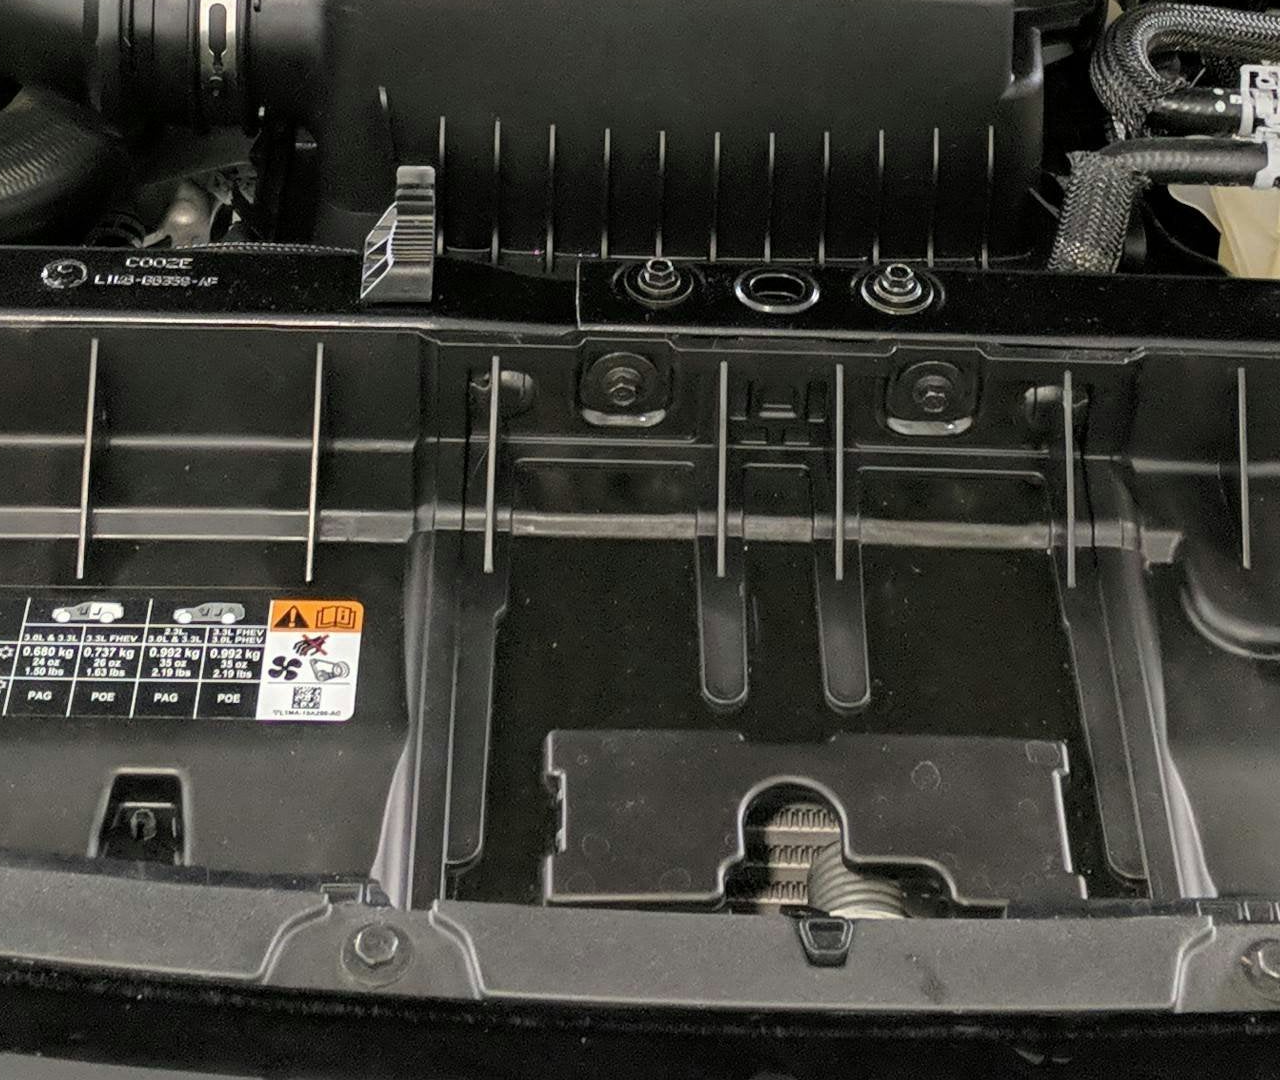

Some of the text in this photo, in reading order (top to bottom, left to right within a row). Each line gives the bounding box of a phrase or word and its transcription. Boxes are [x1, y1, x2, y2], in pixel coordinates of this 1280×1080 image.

[24, 634, 78, 642] 3.0L & 3.3L
[86, 634, 139, 642] 3.3L FHEV
[148, 635, 168, 643] 3.0L
[182, 636, 202, 644] 3.3L
[22, 646, 74, 660] 0.680 kg
[83, 646, 136, 660] 0.737 kg
[148, 646, 200, 660] 0.992 kg
[210, 648, 260, 662] 0.992 kg
[32, 657, 62, 666] 24 oz
[92, 658, 122, 668] 26 oz
[158, 658, 188, 668] 35 oz
[220, 660, 248, 670] 35 oz
[24, 666, 64, 676] 1.50 lbs
[86, 668, 126, 678] 1.63 lbs
[150, 668, 192, 678] 2.19 lbs
[212, 668, 253, 679] 2.19 lbs
[27, 690, 52, 700] PAG
[90, 692, 116, 702] POE
[153, 692, 178, 703] PAG
[216, 693, 241, 704] POE
